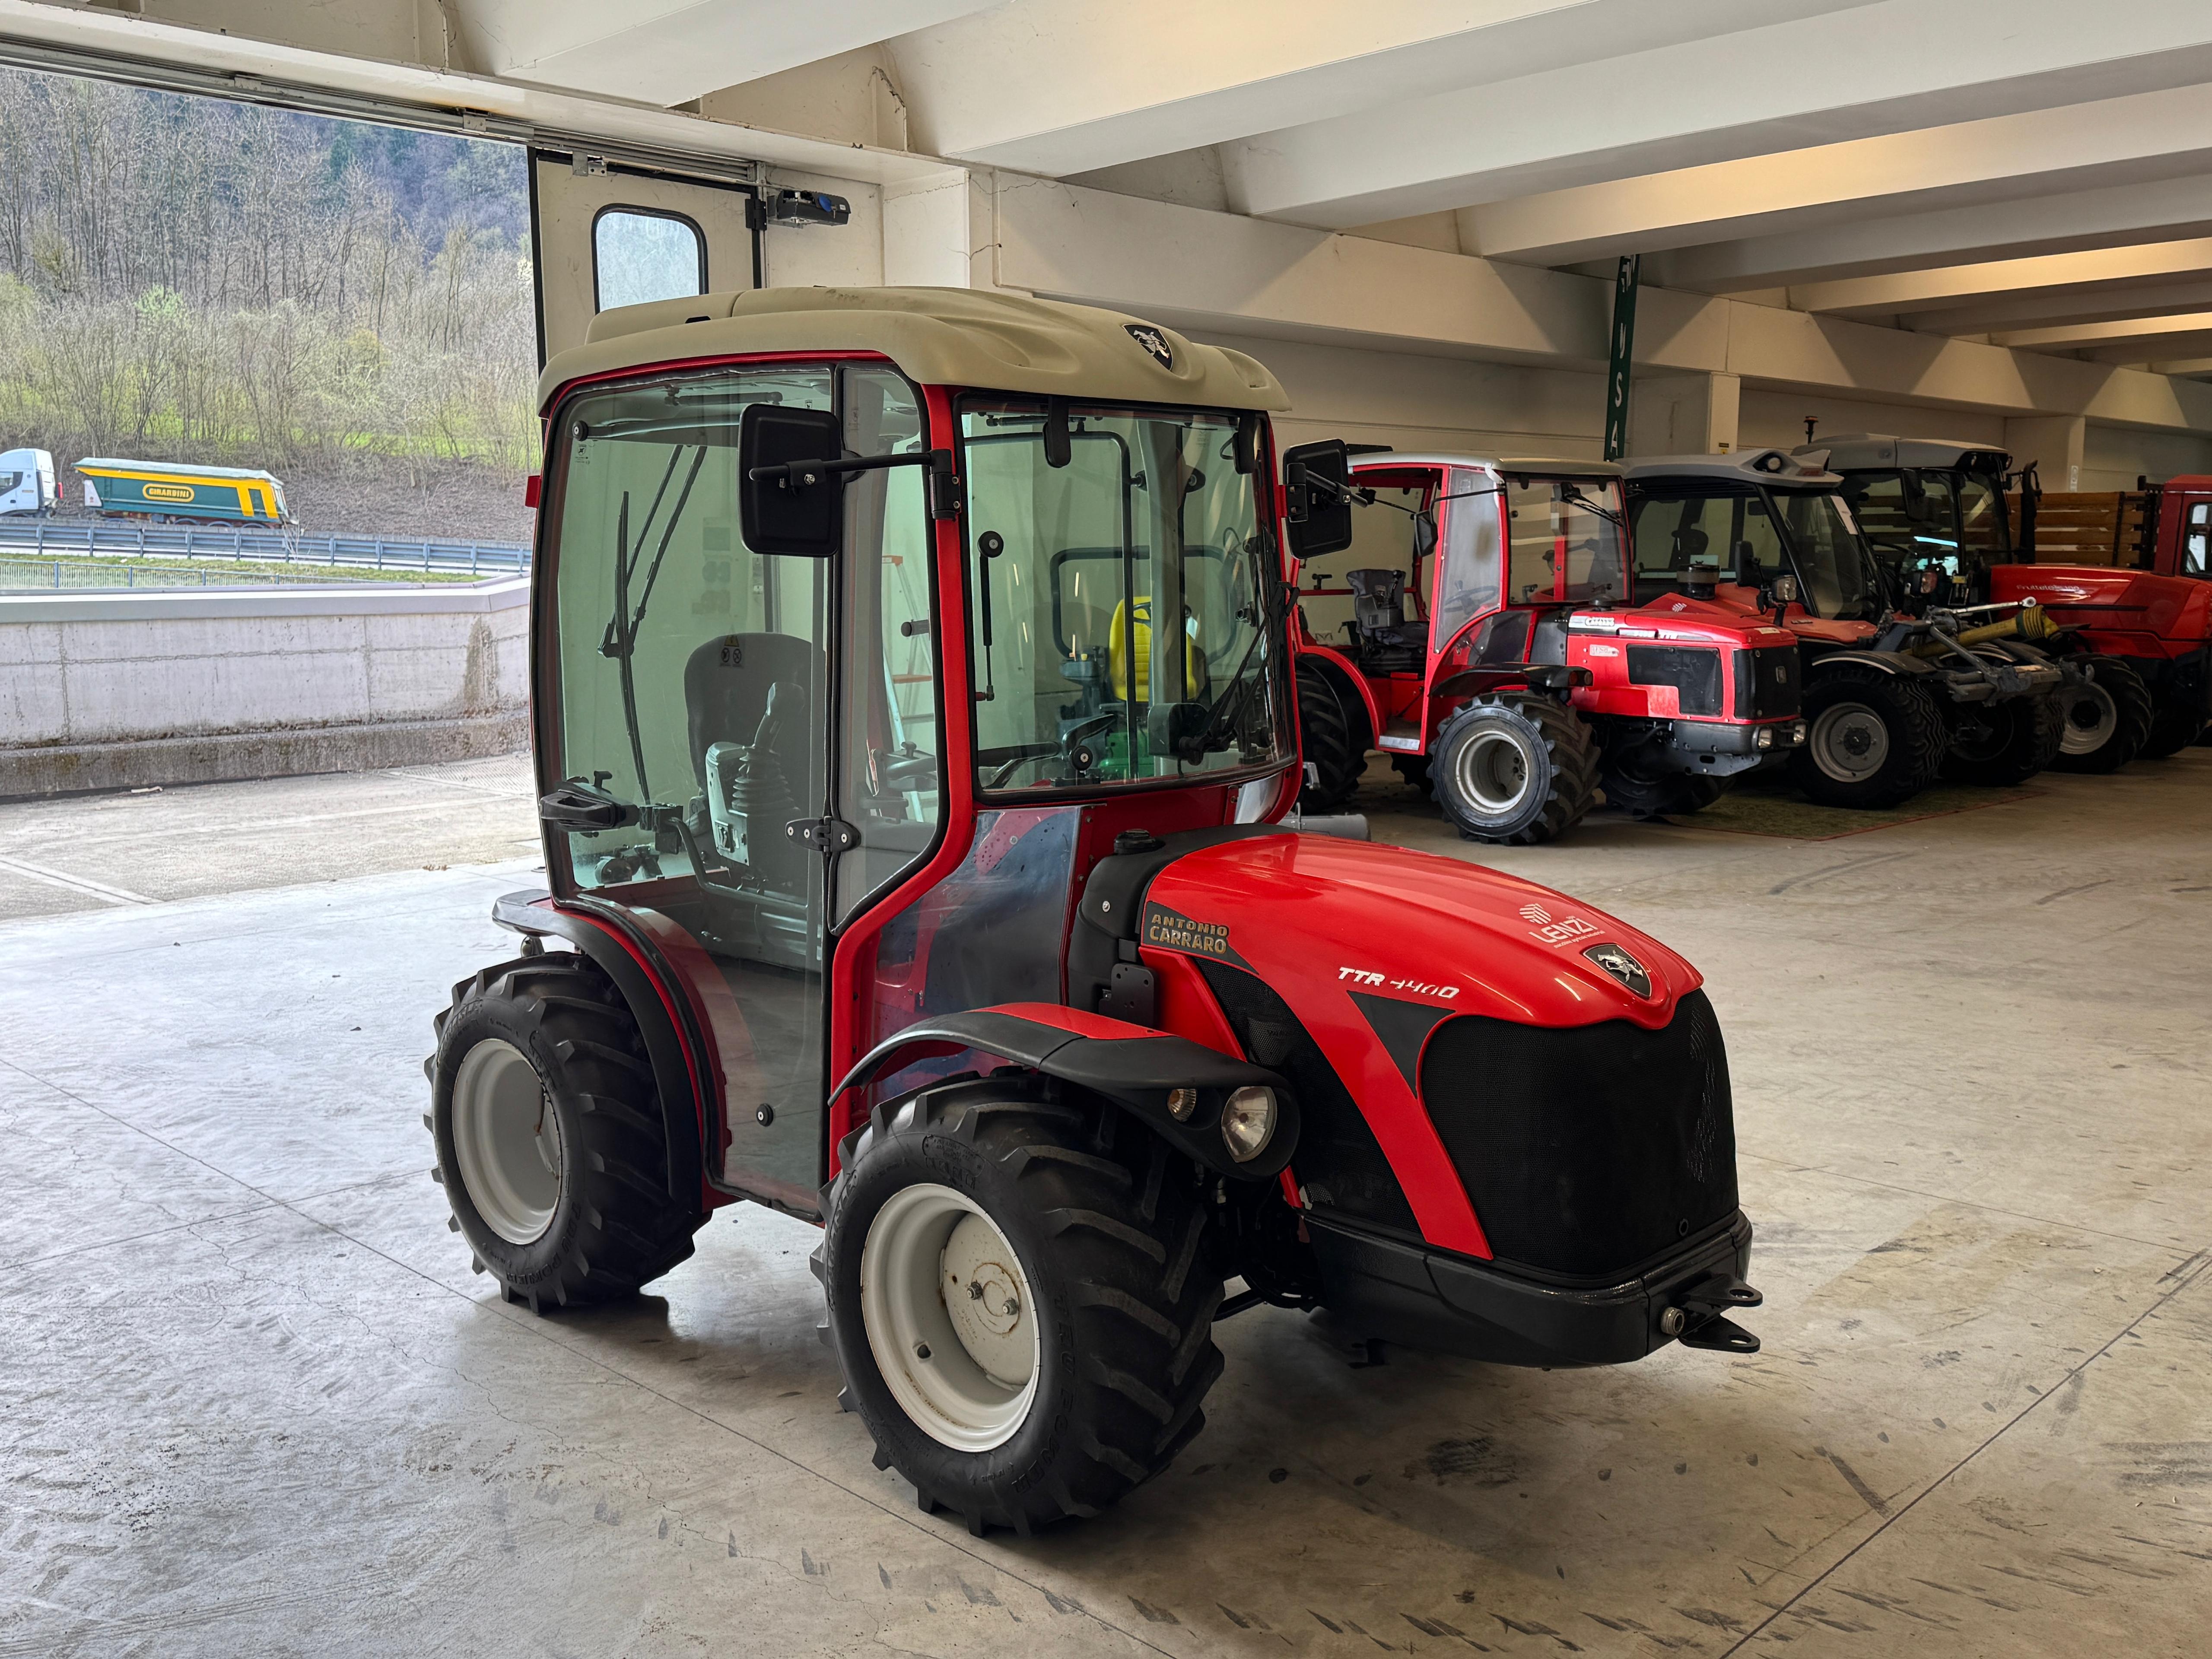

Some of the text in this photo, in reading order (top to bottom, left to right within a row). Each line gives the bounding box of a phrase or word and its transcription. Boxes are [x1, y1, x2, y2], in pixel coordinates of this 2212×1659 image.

[1151, 914, 1228, 937] ANTONIO
[1528, 918, 1599, 944] LENZI
[1150, 925, 1227, 954] CARRARO
[1338, 966, 1386, 986] TTR
